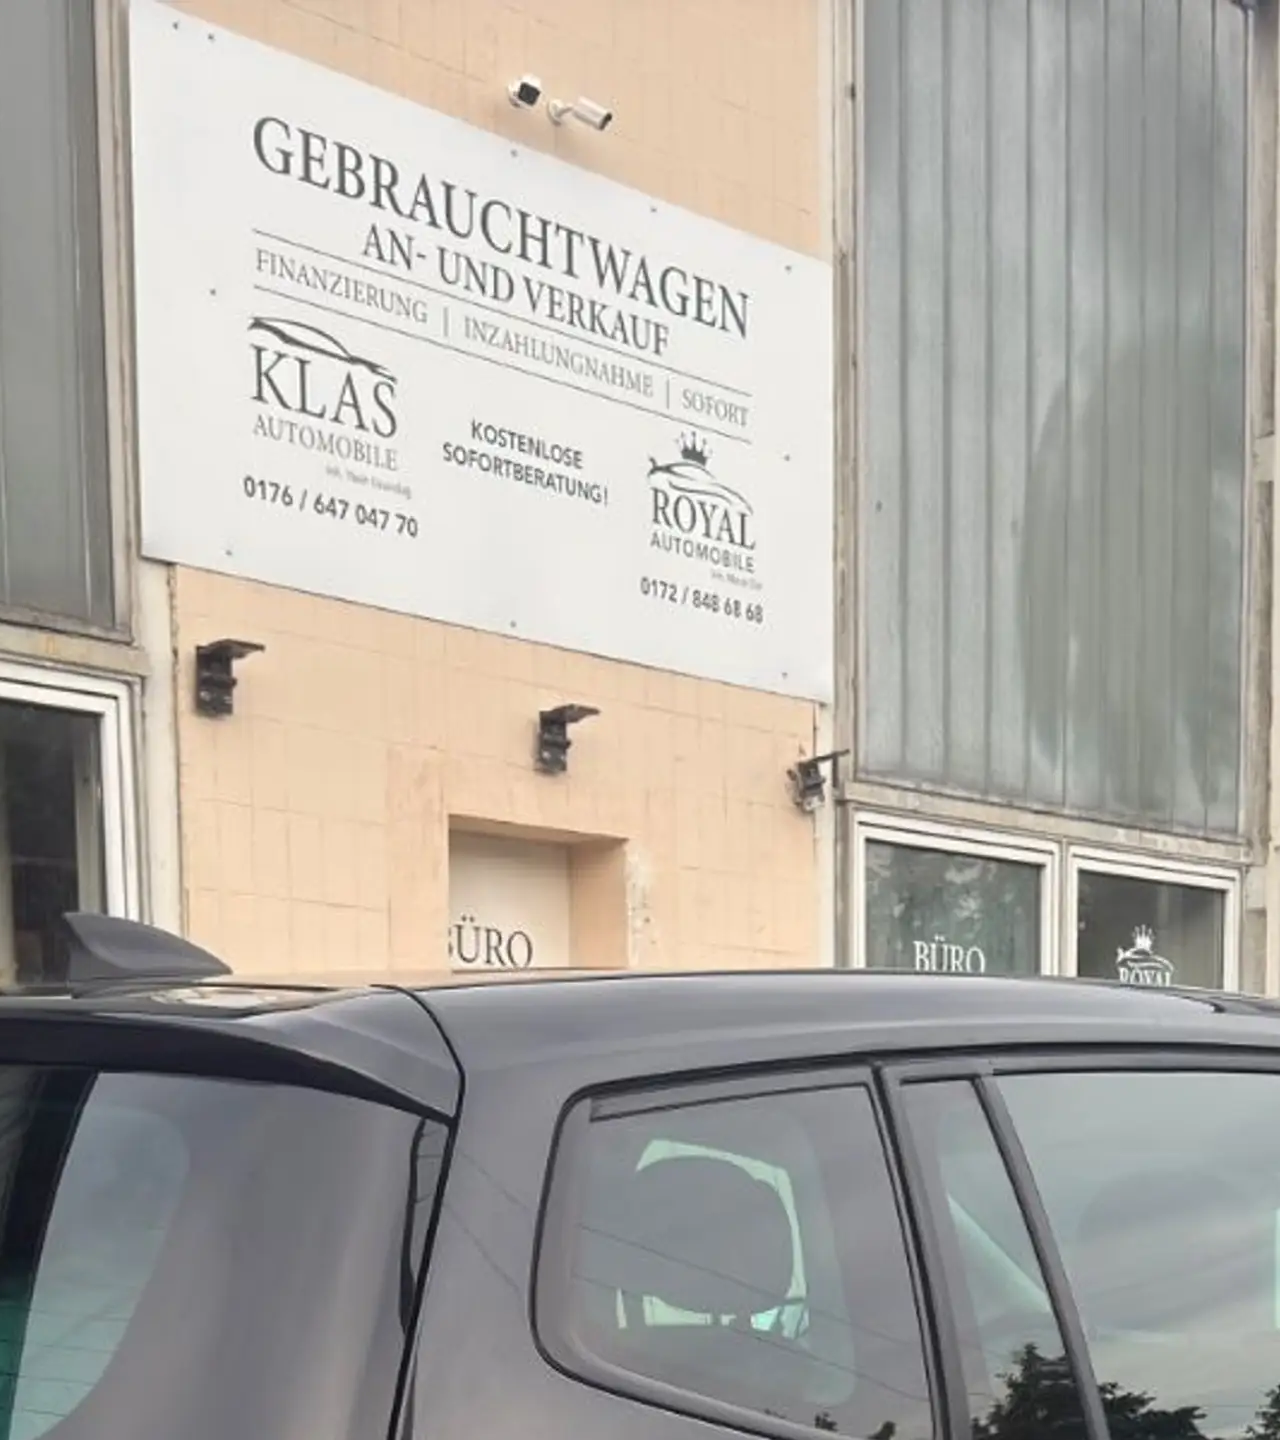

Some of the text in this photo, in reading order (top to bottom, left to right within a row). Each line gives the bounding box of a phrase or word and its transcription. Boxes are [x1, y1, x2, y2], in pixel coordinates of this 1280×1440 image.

[253, 116, 750, 340] GEBRAUCHTWAGEN
[363, 222, 670, 357] AN- UND VERKAUF
[256, 248, 749, 428] FINANZIERUNG INZAHLUNGNAHME SOFORT
[250, 343, 397, 438] KLAS
[253, 413, 397, 472] AUTOMOBILE
[442, 440, 609, 508] SOFORTBERATUNG!
[471, 418, 583, 470] KOSTENLOSE
[243, 474, 294, 507] 0176
[313, 493, 349, 520] 647
[355, 503, 390, 531] 047
[394, 512, 419, 539] 70
[651, 486, 756, 550] ROYAL
[650, 530, 755, 574] AUTOMOBILE
[640, 576, 678, 604] 0172
[448, 914, 533, 969] ÜRO
[913, 934, 986, 974] BÜRO
